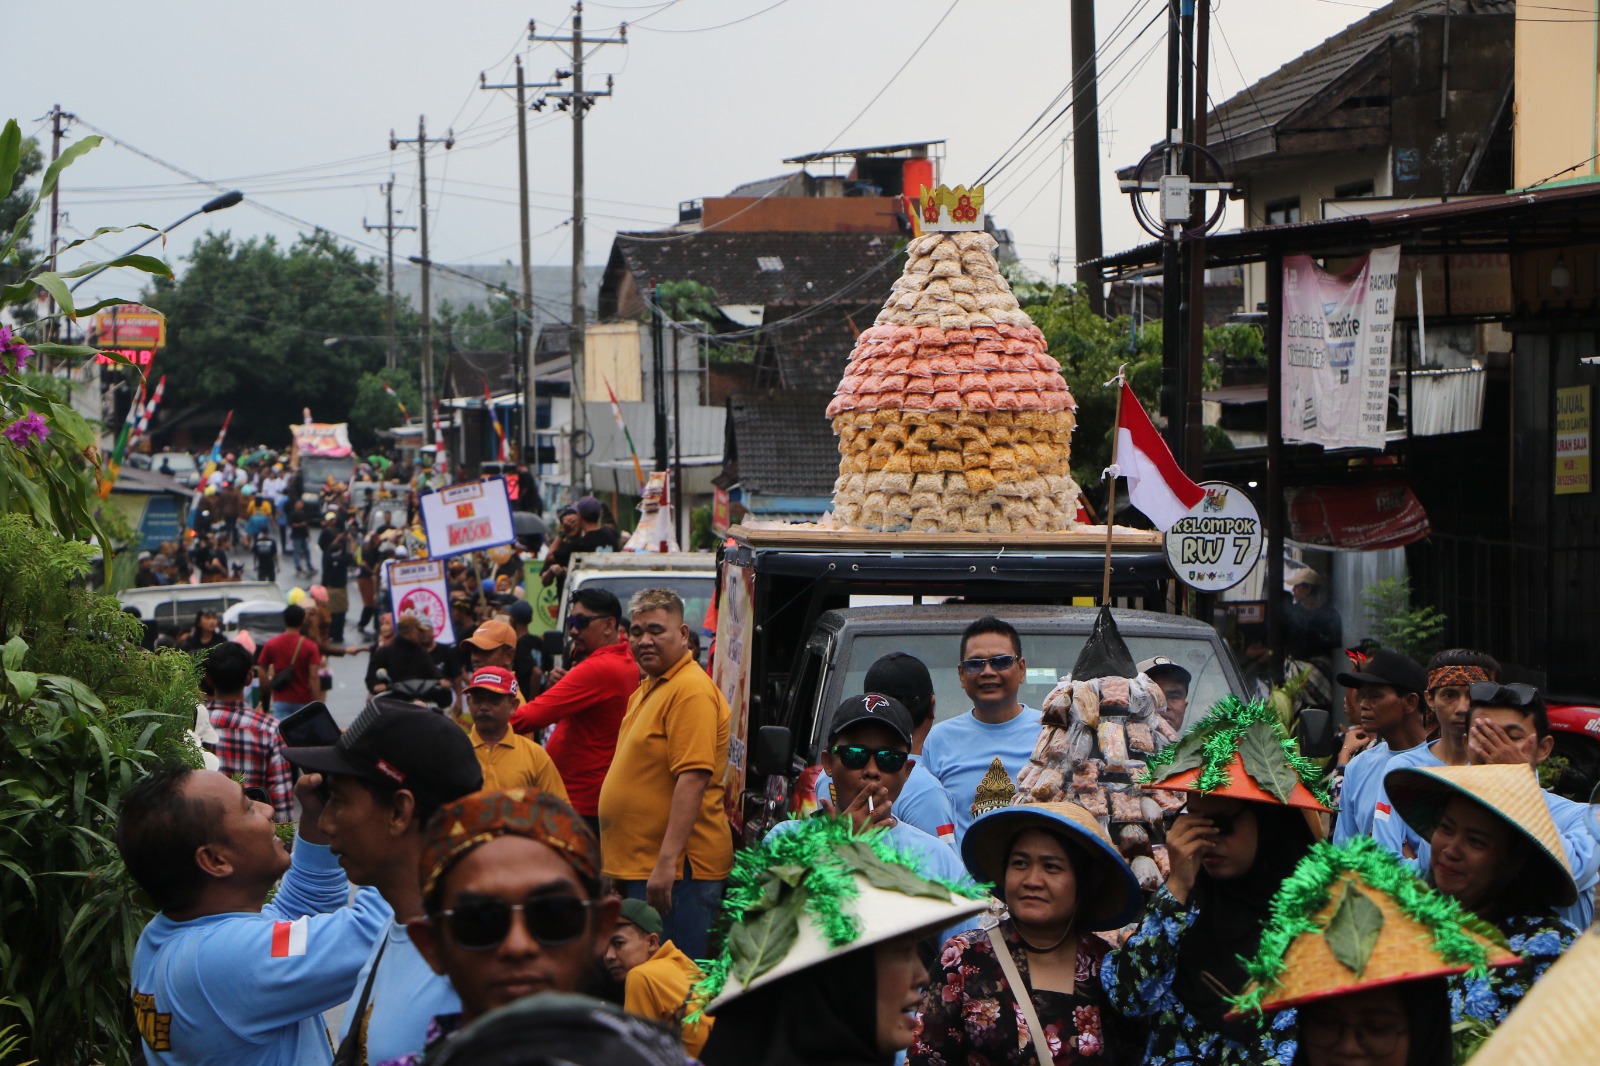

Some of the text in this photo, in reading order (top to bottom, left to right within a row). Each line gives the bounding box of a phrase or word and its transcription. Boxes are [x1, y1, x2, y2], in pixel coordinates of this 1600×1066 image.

[1573, 437, 1587, 451] SAJA
[1172, 517, 1257, 535] KELOMPOK
[1182, 536, 1251, 565] RW 7
